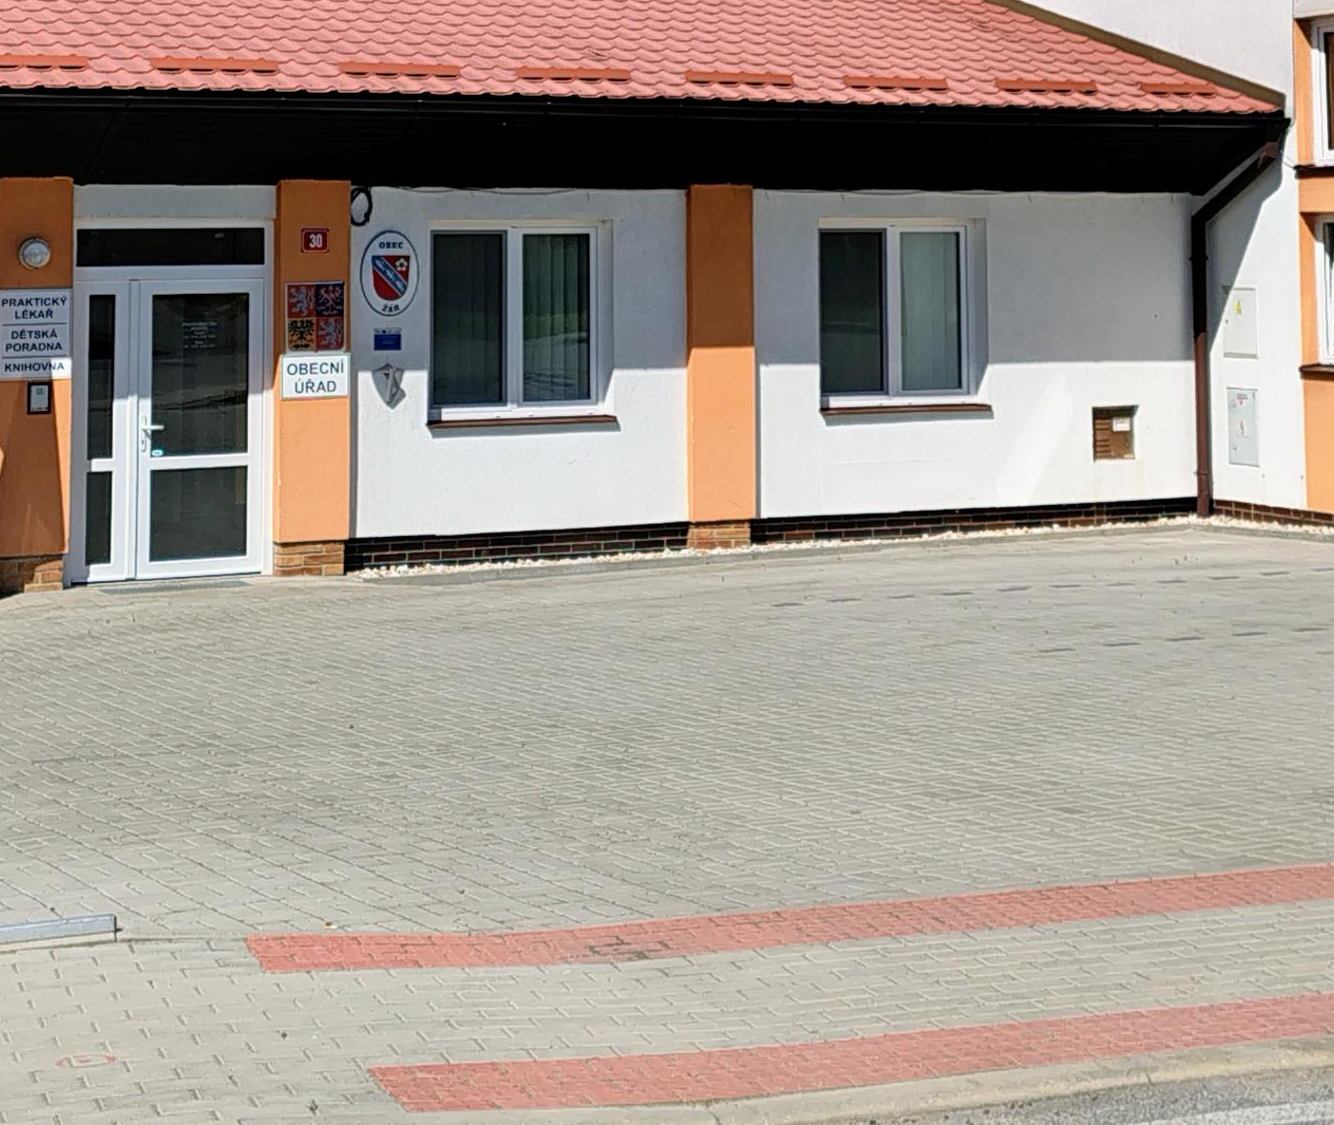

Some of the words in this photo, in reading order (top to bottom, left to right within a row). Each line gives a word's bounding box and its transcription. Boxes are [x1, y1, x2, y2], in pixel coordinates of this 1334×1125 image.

[308, 233, 323, 248] 30
[378, 241, 404, 249] OBEC
[1, 295, 68, 307] PRAKTICKÝ
[14, 308, 54, 320] LÉKAŘ
[10, 328, 58, 340] DĚTSKÁ
[5, 342, 63, 352] PORADNA
[4, 362, 65, 373] KNIHOVNA
[286, 359, 344, 375] OBECNÍ
[294, 378, 337, 394] ÚŘAD
